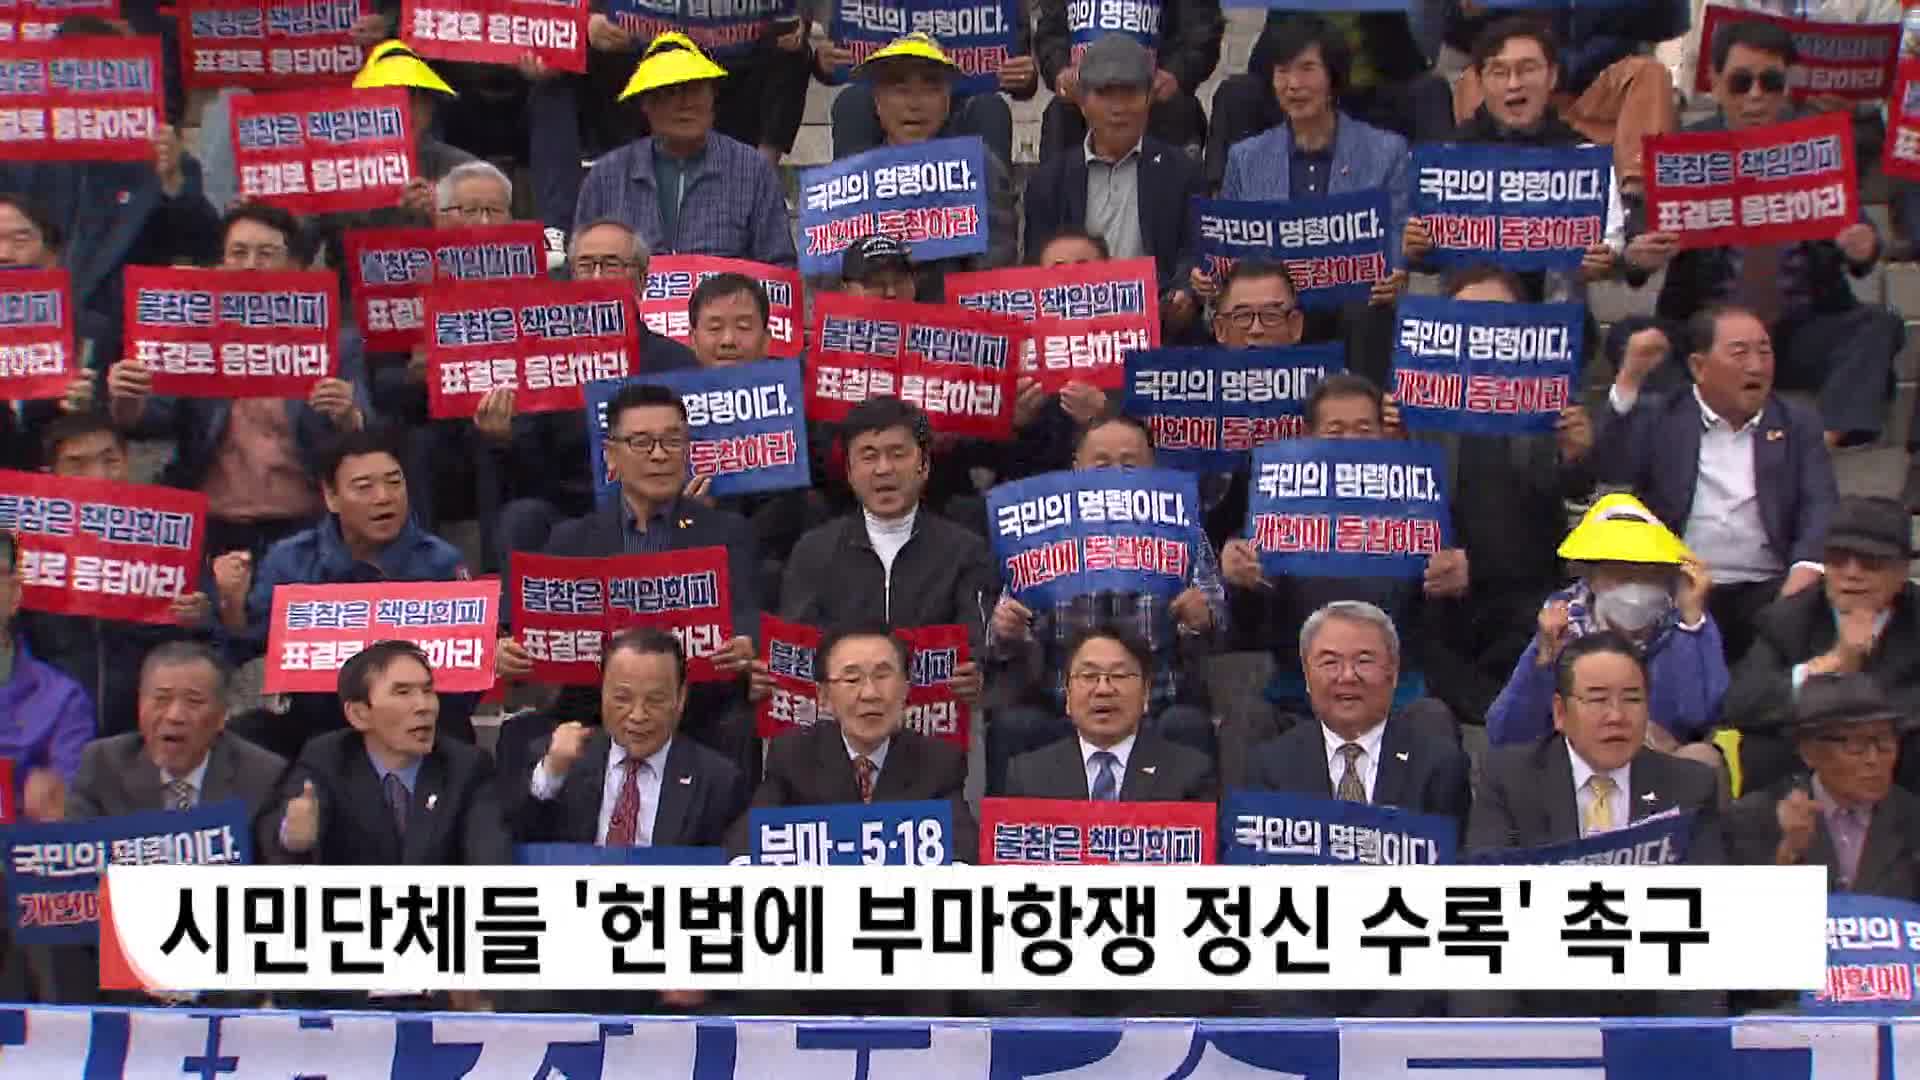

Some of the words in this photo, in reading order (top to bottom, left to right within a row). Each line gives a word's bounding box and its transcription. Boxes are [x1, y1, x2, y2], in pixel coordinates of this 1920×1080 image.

[911, 6, 1009, 36] 명령이다.
[1066, 0, 1096, 32] 민의
[1099, 0, 1160, 33] 명령이
[0, 108, 47, 141] 결로
[806, 170, 869, 212] 국민의
[874, 159, 977, 203] 명령이다.
[1419, 167, 1494, 202] 국민의
[1500, 167, 1602, 201] 명령이다.
[1200, 213, 1273, 247] 국민의
[1279, 207, 1385, 247] 명령이다.
[641, 270, 694, 302] 참은
[367, 297, 425, 333] 표결
[640, 310, 691, 338] 결로
[1400, 317, 1463, 359] 국민의
[1468, 324, 1572, 362] 명령이다.
[1135, 370, 1215, 401] 국민의
[1257, 461, 1328, 499] 국민의
[1334, 463, 1441, 501] 명령이다.
[79, 504, 193, 549] 책임회피
[998, 496, 1073, 540] 국민의
[1077, 490, 1190, 529] 명령이다.
[20, 549, 67, 588] 결로
[375, 596, 488, 629] 책임회피
[993, 823, 1082, 863] 불참은
[1233, 815, 1322, 858] 국민의
[12, 840, 105, 878] 국민의
